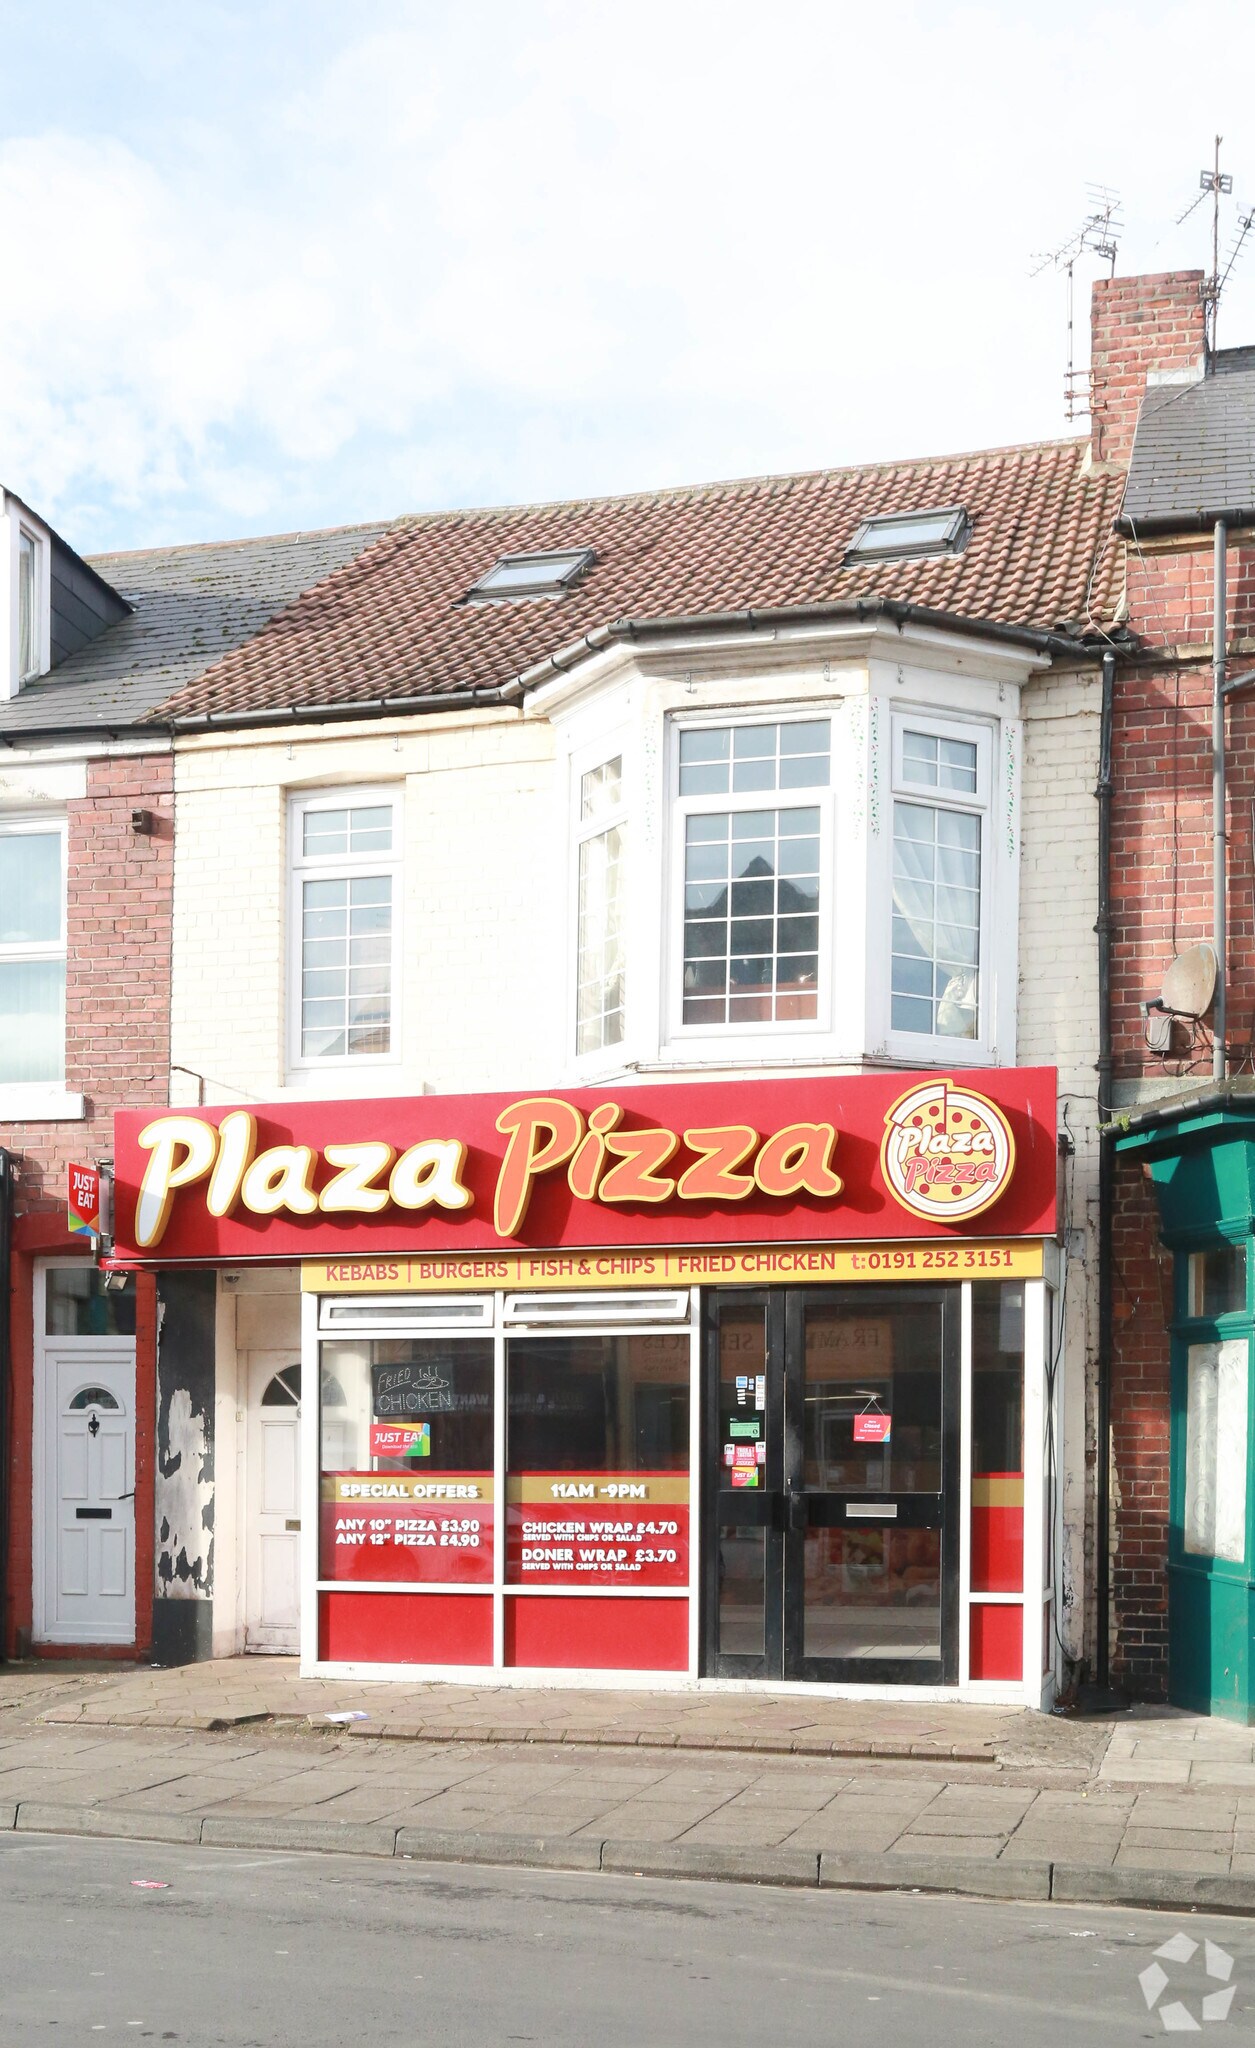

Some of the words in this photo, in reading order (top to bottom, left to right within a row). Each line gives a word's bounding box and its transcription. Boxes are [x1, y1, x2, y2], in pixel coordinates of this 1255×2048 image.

[897, 1124, 995, 1163] Plaza
[135, 1110, 474, 1247] Plaza
[494, 1097, 845, 1238] Pizza
[904, 1156, 998, 1193] Pizza
[73, 1171, 95, 1192] JUST
[77, 1190, 95, 1209] EAT
[326, 1264, 399, 1281] KEBABS
[420, 1260, 508, 1279] BURGERS
[530, 1258, 573, 1276] FISH
[577, 1258, 591, 1275] &
[596, 1257, 655, 1275] CHIPS
[678, 1255, 736, 1272] FRIED
[741, 1252, 836, 1271] CHICKEN
[922, 1251, 959, 1268] 252
[964, 1250, 1013, 1267] 3151
[377, 1367, 411, 1394] FRIED
[378, 1390, 451, 1411] CHICKEN
[374, 1432, 401, 1444] JUST
[403, 1432, 424, 1442] EAT
[340, 1484, 409, 1497] SPECIAL
[413, 1484, 478, 1498] OFFERS
[550, 1483, 594, 1498] 11AM
[600, 1484, 646, 1498] -9PM
[335, 1519, 366, 1530] ANY
[395, 1519, 437, 1532] PIZZA
[441, 1519, 480, 1532] £3.90
[522, 1522, 585, 1534] CHICKEN
[589, 1522, 633, 1534] WRAP
[636, 1521, 678, 1535] £4.70
[335, 1533, 366, 1545] ANY
[394, 1534, 436, 1546] PIZZA
[440, 1534, 480, 1547] £4.90
[615, 1534, 642, 1542] SALAD
[521, 1548, 573, 1561] DONER
[579, 1549, 627, 1562] WRAP
[635, 1549, 677, 1563] £3.70
[601, 1563, 612, 1571] OR
[615, 1563, 641, 1571] SALAD
